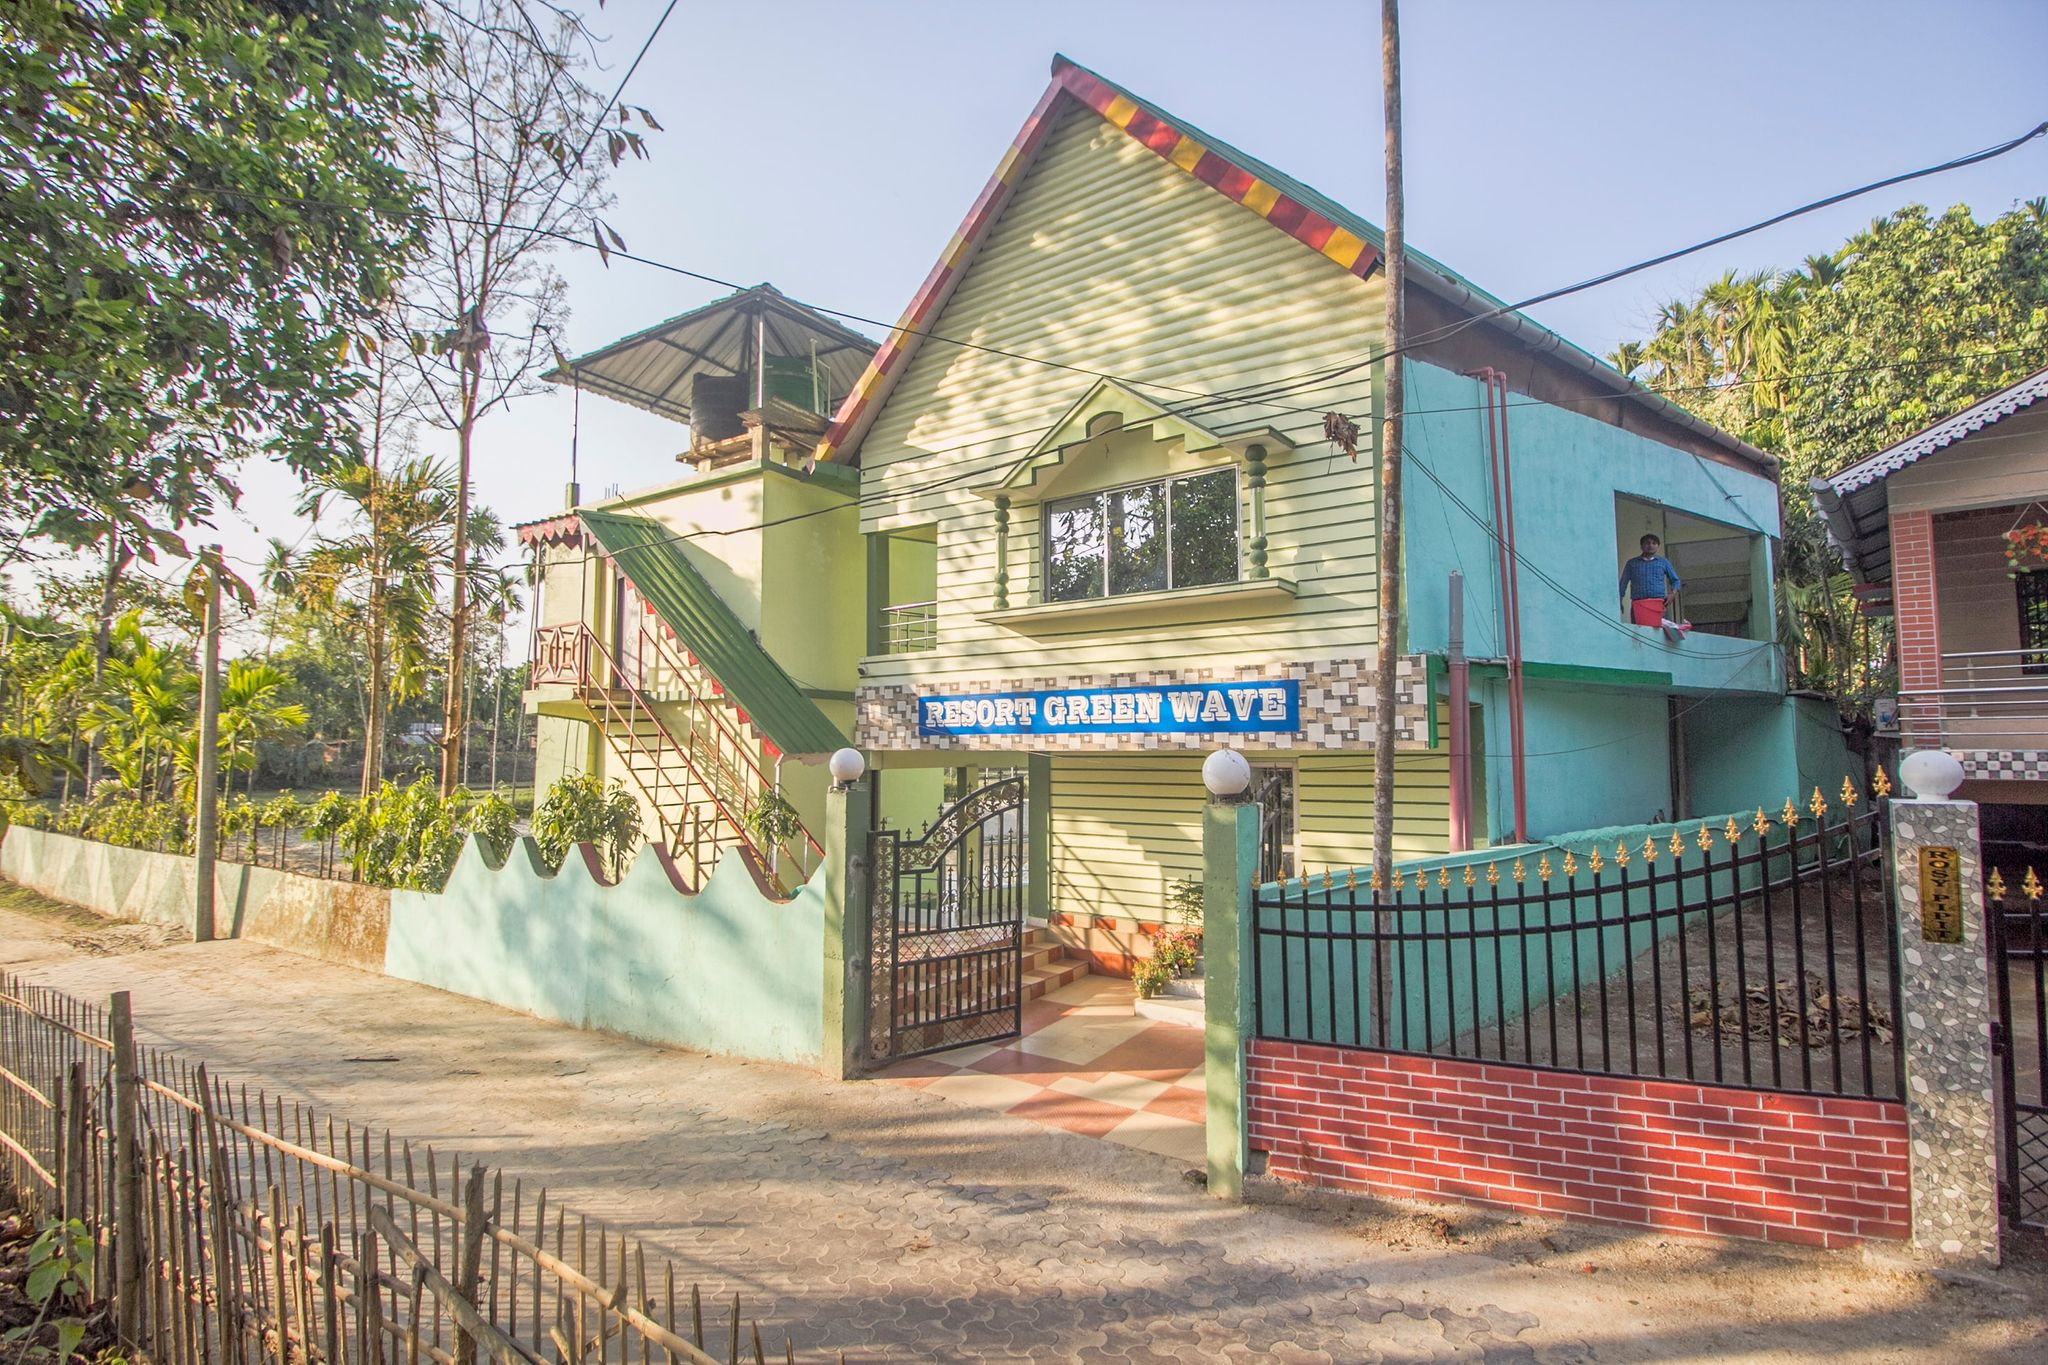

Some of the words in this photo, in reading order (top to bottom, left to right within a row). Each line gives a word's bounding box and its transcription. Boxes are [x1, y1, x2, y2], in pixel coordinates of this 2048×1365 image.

[926, 696, 1036, 728] RESORT
[1043, 692, 1161, 725] GREEN
[1167, 687, 1287, 722] WAVE
[1928, 850, 1949, 888] ROSY
[1933, 894, 1952, 939] PIPIT
